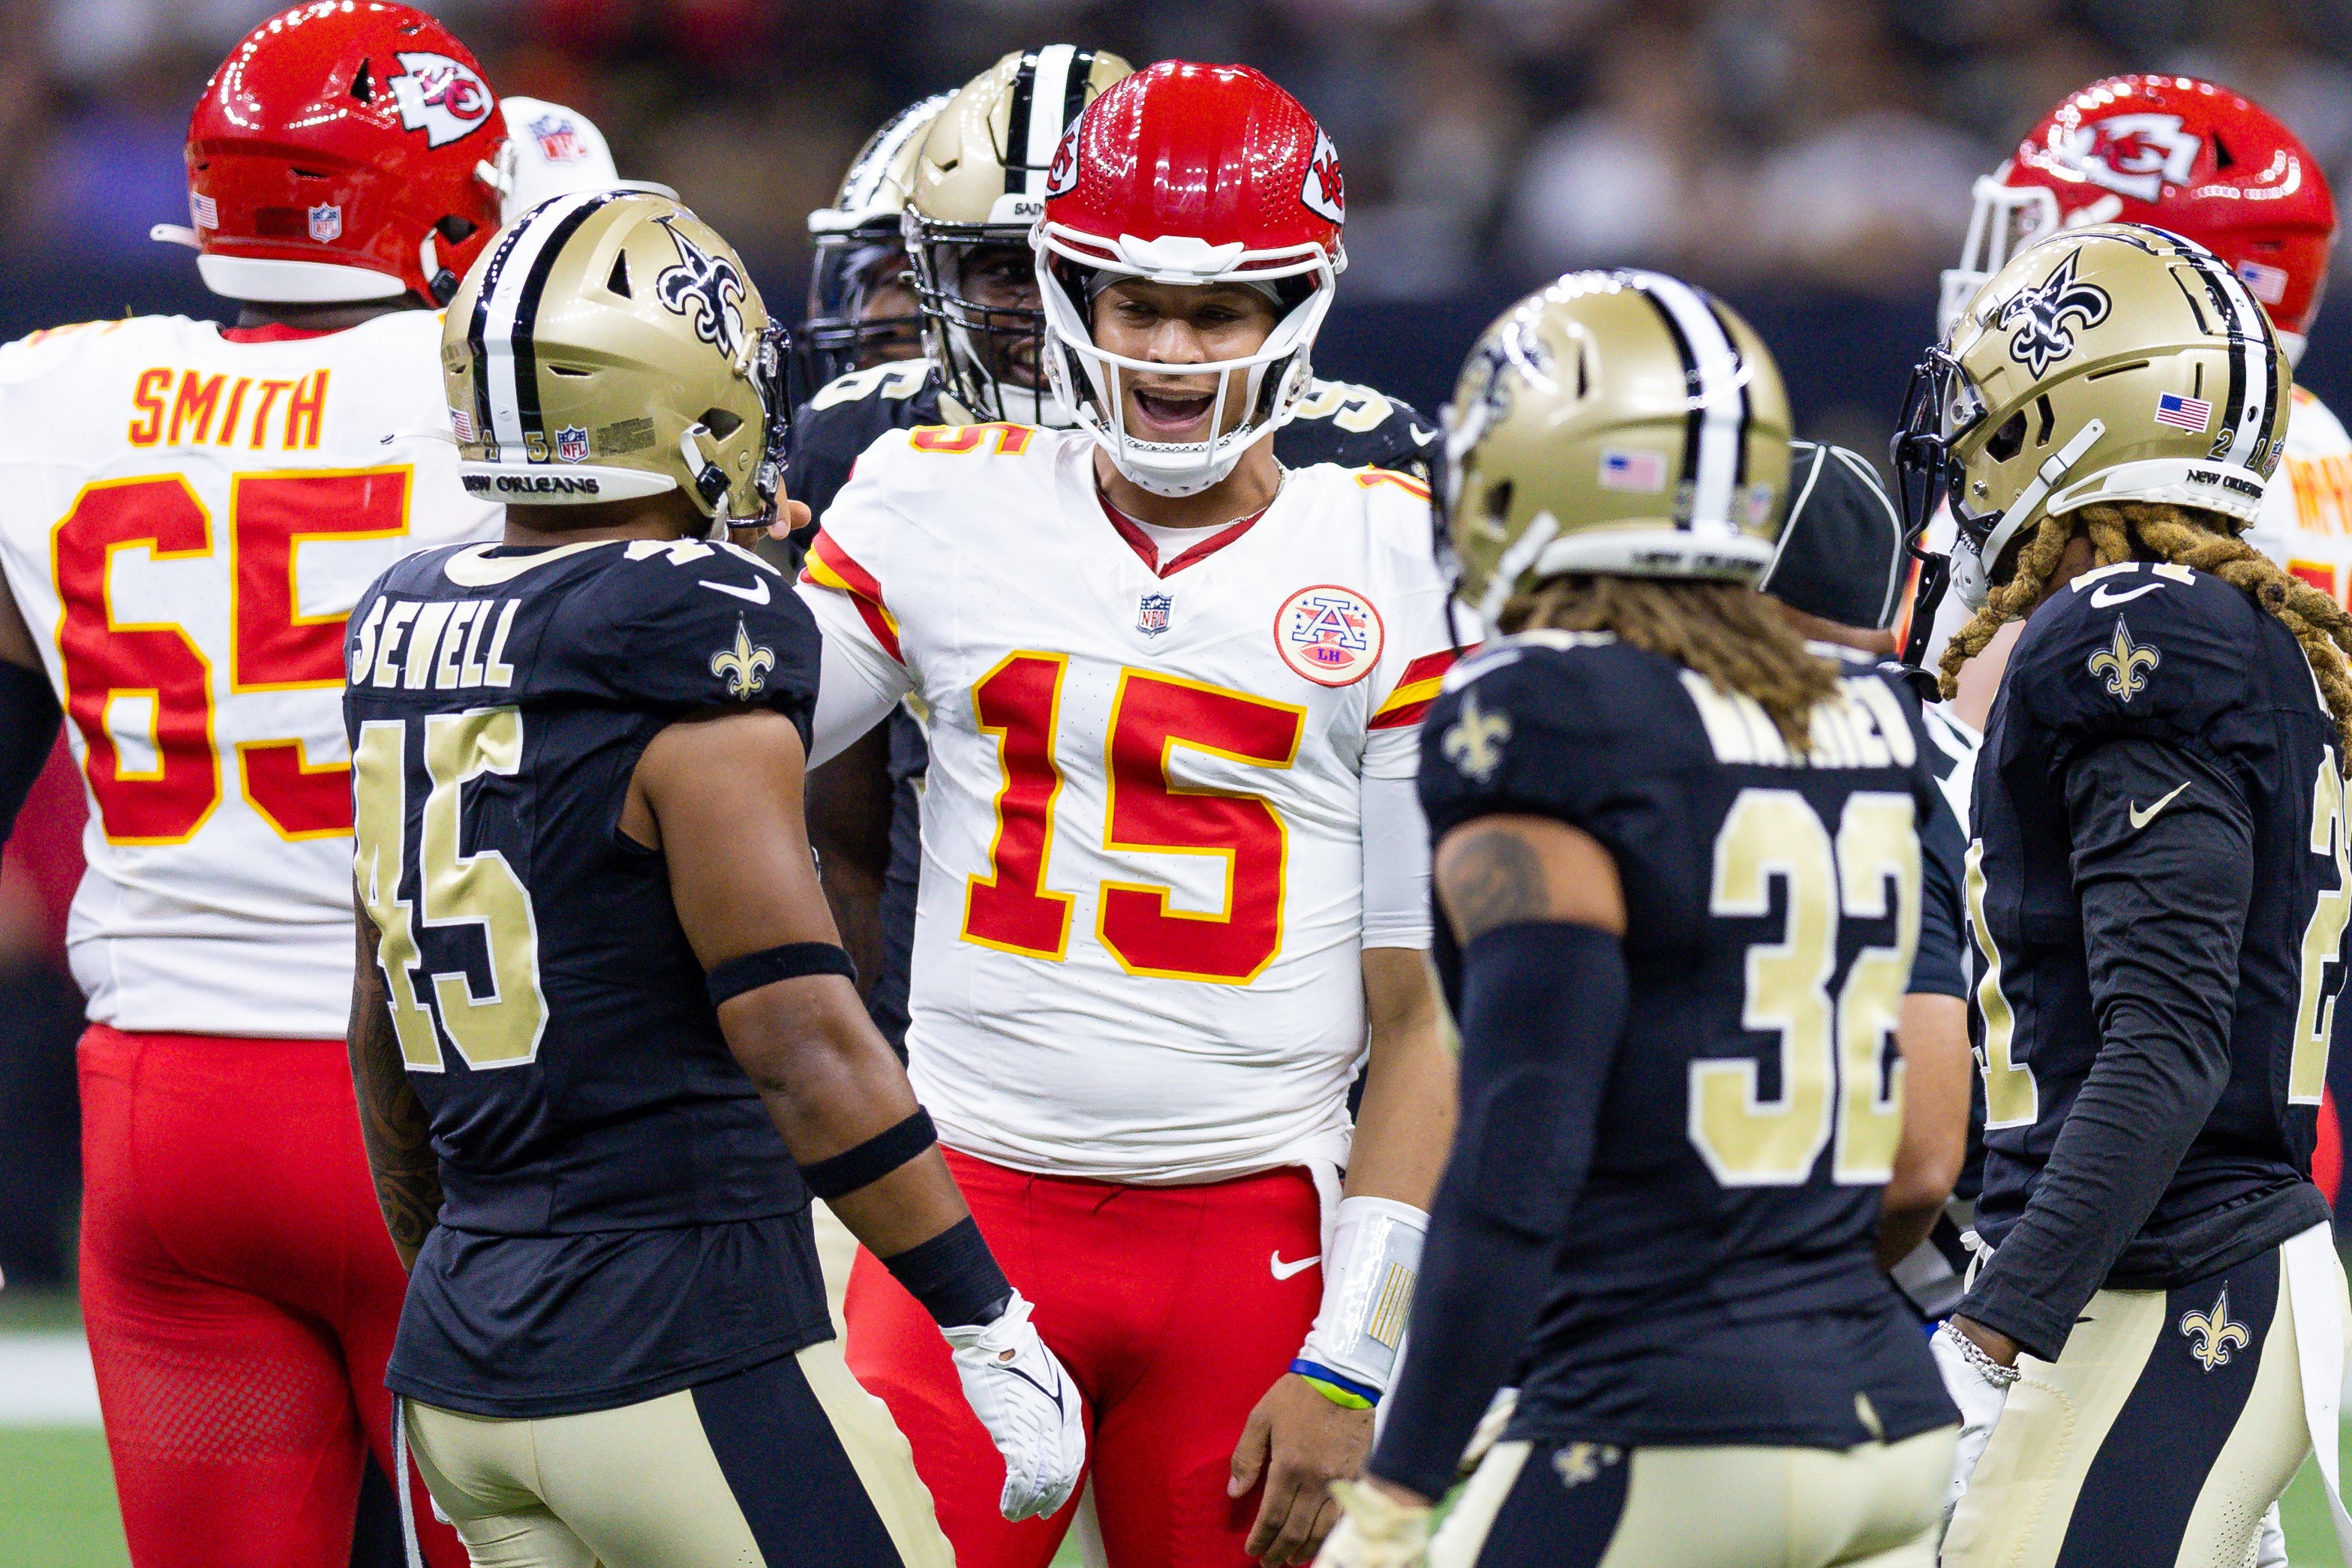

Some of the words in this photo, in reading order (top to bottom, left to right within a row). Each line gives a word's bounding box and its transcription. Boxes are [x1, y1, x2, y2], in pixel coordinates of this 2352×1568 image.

[127, 367, 332, 451] SMITH
[561, 443, 587, 458] NFL
[2185, 469, 2221, 485] NEW
[495, 475, 600, 495] ORLEANS
[351, 595, 522, 689] SEWELL
[1140, 611, 1166, 628] NFL
[1291, 597, 1367, 650] A
[50, 463, 414, 846] 65
[1317, 648, 1341, 662] LH
[960, 648, 1308, 987] 15
[353, 704, 550, 1073] 45
[1687, 787, 1923, 1187] 32
